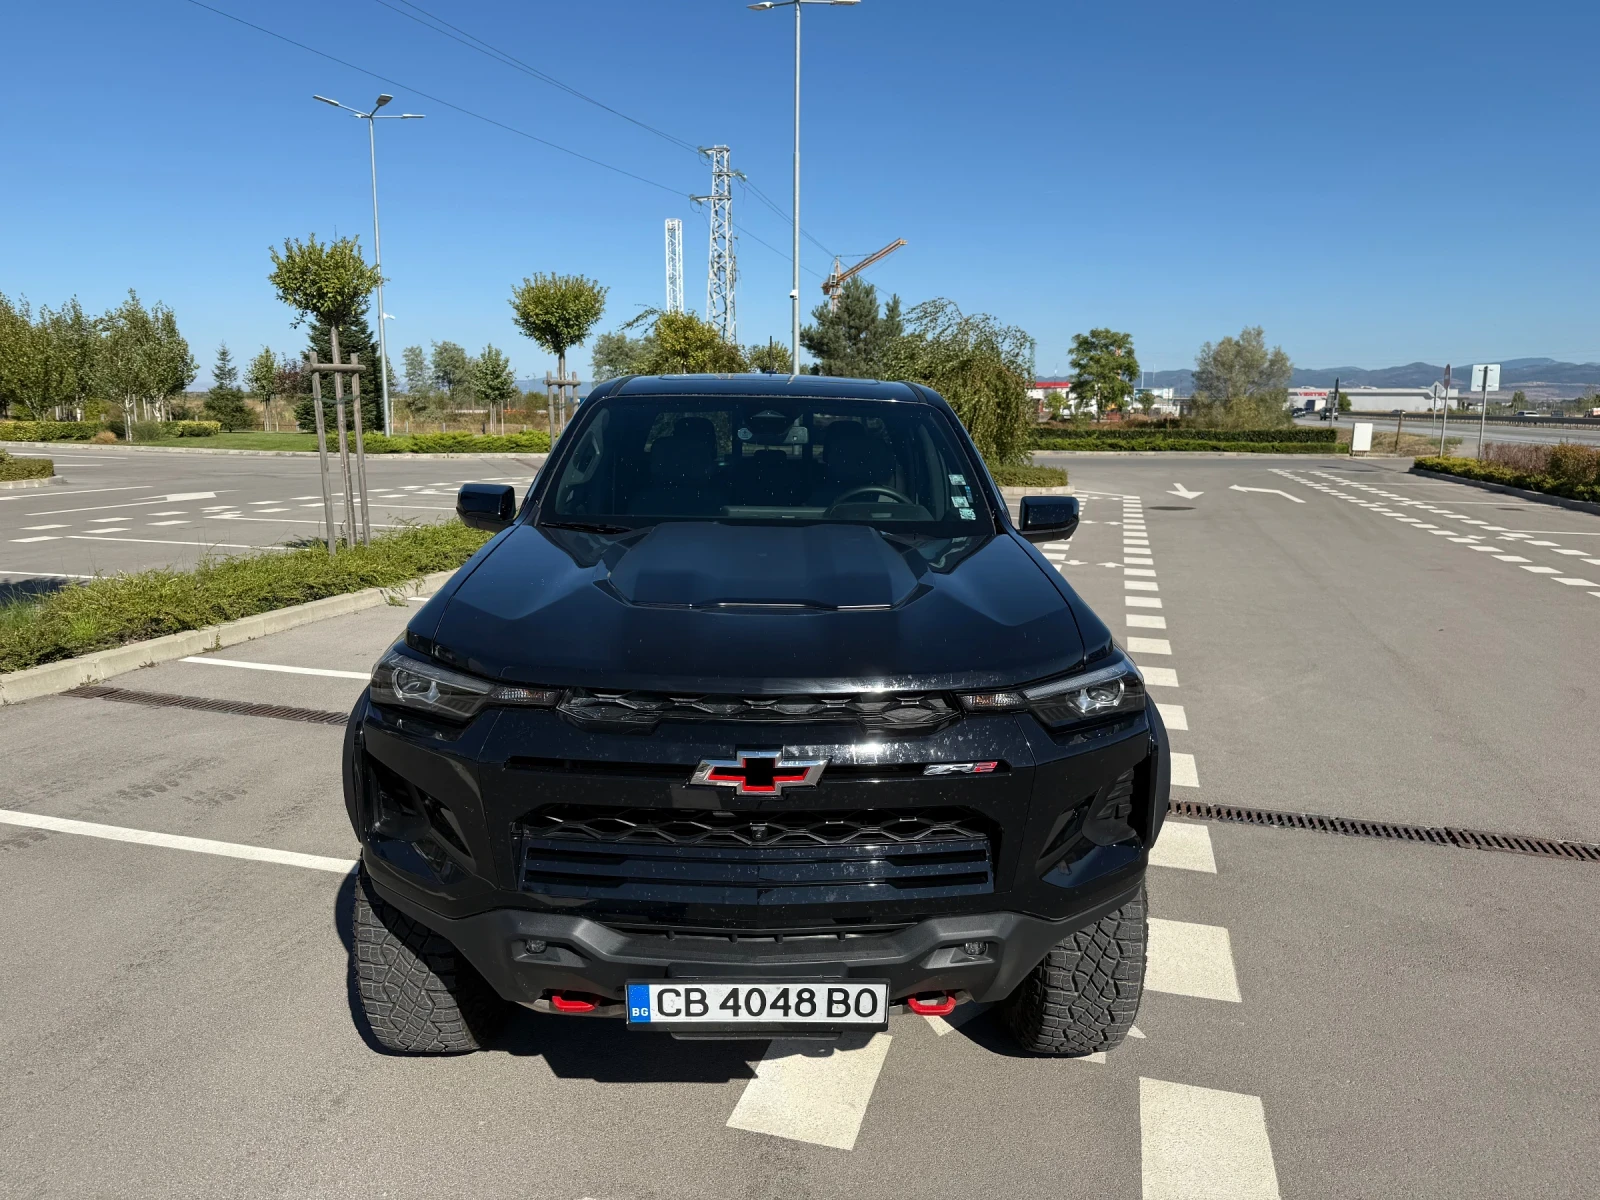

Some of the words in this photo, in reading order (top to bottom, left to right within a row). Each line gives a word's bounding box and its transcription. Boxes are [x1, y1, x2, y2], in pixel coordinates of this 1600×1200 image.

[657, 987, 709, 1017] CB
[719, 987, 817, 1017] 4048
[826, 987, 878, 1017] BO
[632, 1008, 649, 1017] BG
